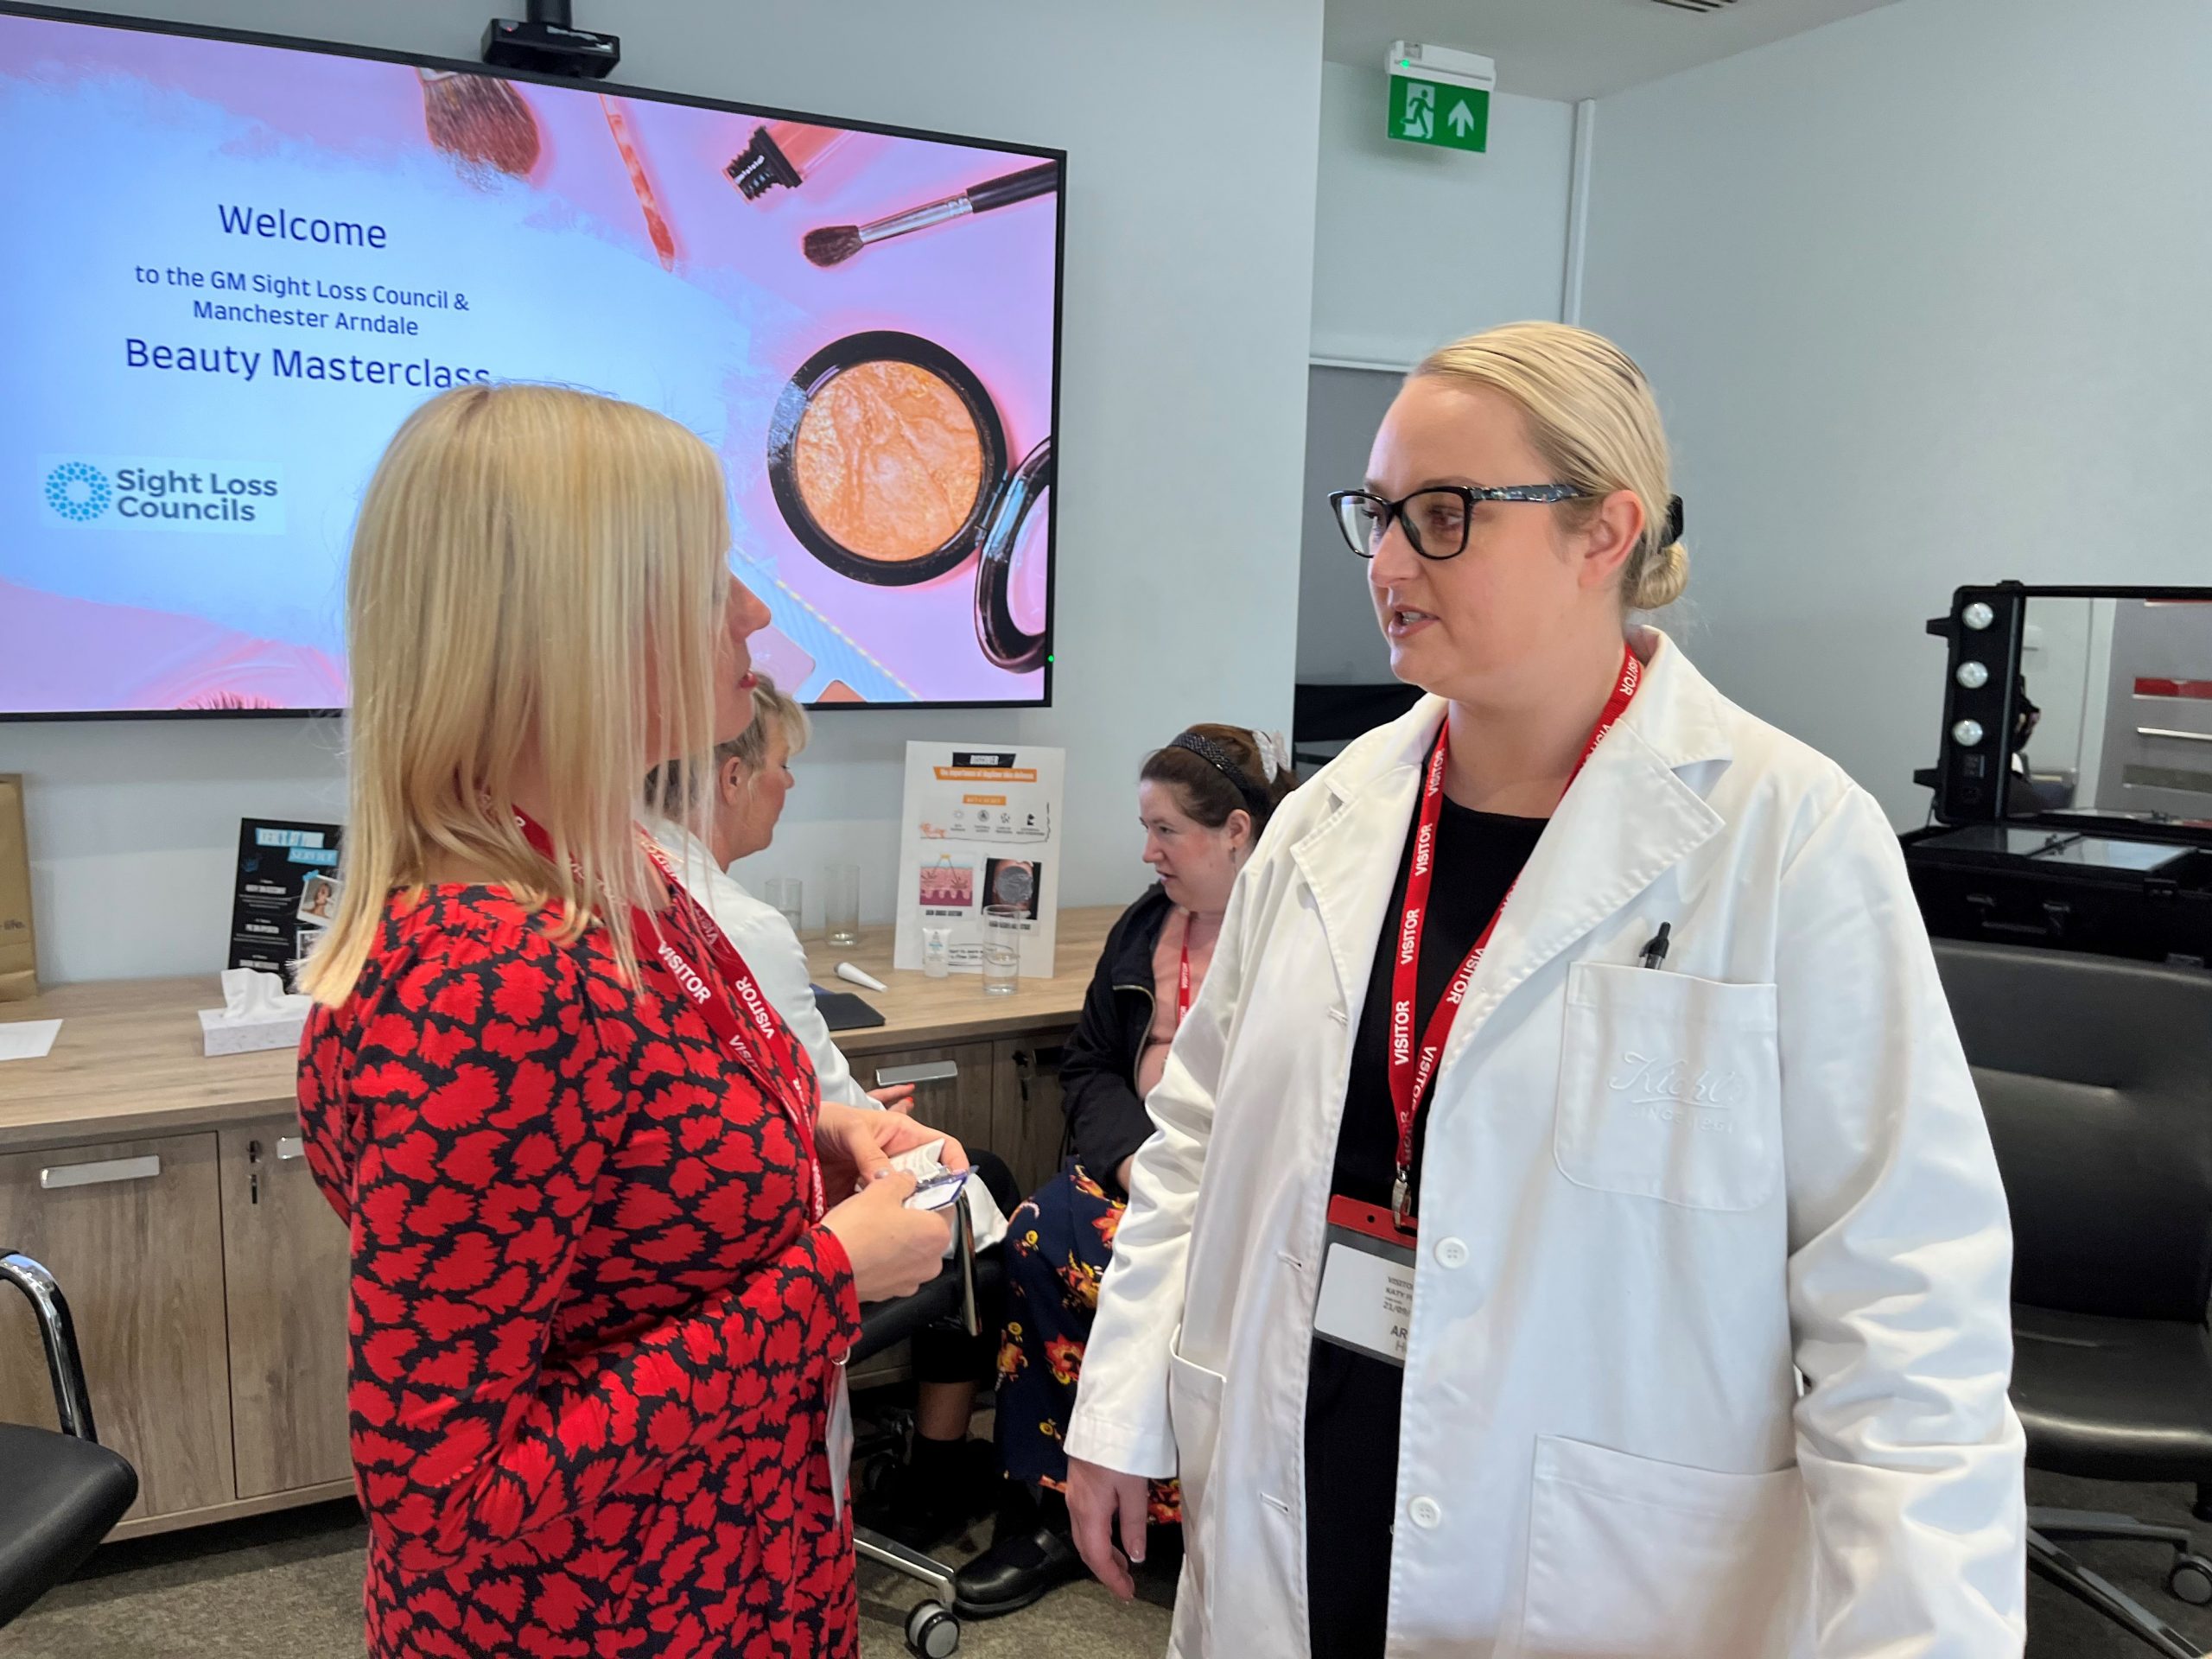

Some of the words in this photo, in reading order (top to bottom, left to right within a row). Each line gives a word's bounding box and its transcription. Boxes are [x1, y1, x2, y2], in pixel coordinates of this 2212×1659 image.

[218, 204, 387, 248] Welcome
[136, 265, 159, 283] to
[167, 267, 205, 288] the
[211, 271, 246, 292] GM
[252, 274, 311, 298] Sight
[317, 280, 367, 301] Loss
[373, 285, 448, 309] Council
[454, 292, 469, 310] &
[193, 301, 328, 329] Manchester
[335, 312, 419, 335] Arndale
[125, 338, 261, 381] Beauty
[272, 348, 490, 389] Masterclass
[116, 469, 203, 498] Sight
[210, 473, 277, 497] Loss
[117, 497, 257, 522] Councils
[1619, 654, 1639, 696] VISITOR
[1427, 747, 1446, 797] VISITOR
[1415, 823, 1433, 876] VISITOR
[1401, 908, 1421, 965] VISITOR
[658, 940, 711, 1005] VISITOR
[1446, 948, 1486, 1005] VISITOR
[735, 976, 775, 1039] VISITOR
[1394, 1000, 1410, 1065] VISITOR
